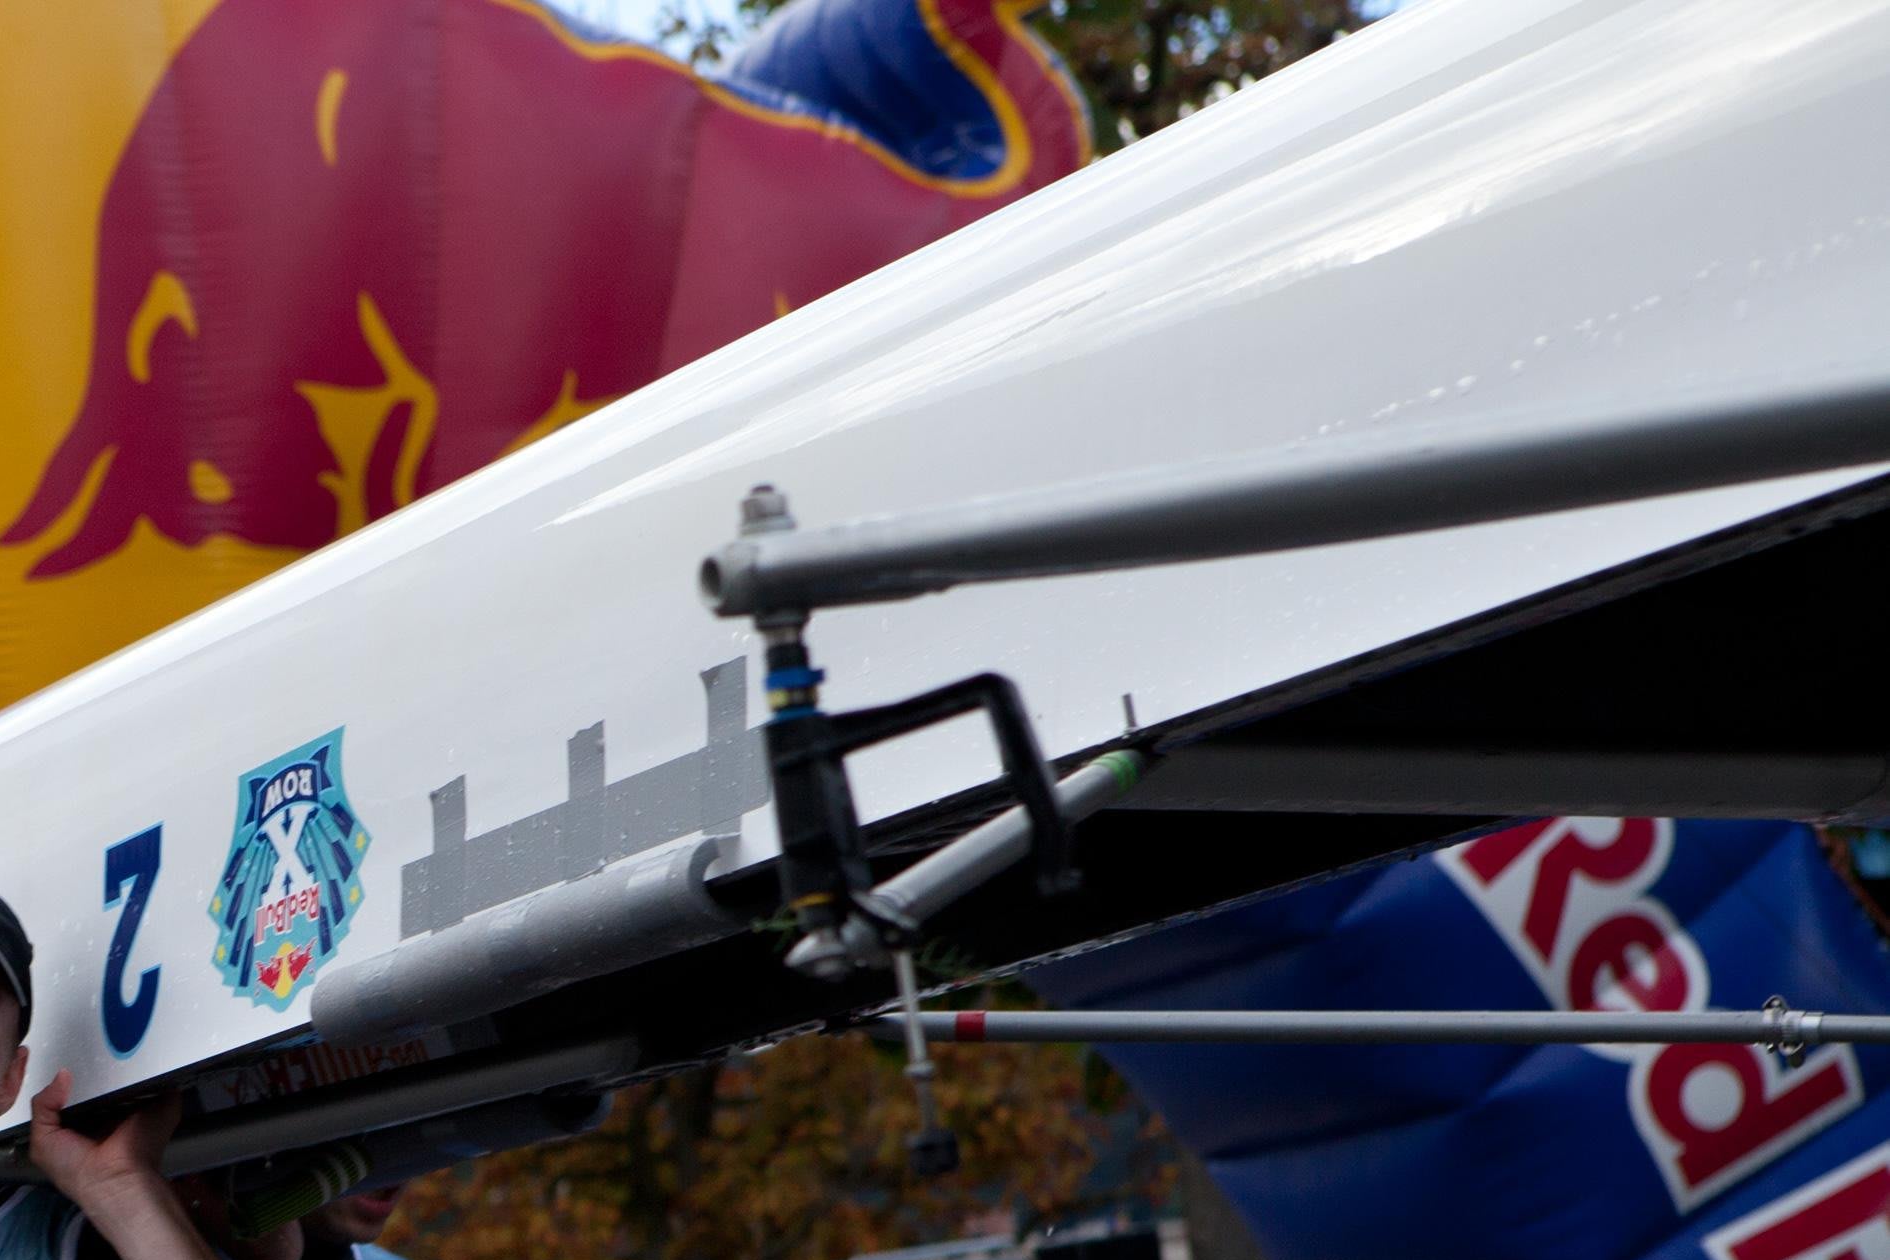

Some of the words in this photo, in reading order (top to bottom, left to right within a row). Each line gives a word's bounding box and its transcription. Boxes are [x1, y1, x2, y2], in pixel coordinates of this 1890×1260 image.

[261, 768, 315, 818] ROW
[254, 896, 289, 946] Bull
[287, 884, 320, 932] Red
[102, 822, 163, 1060] 2
[1450, 817, 1855, 1202] Red
